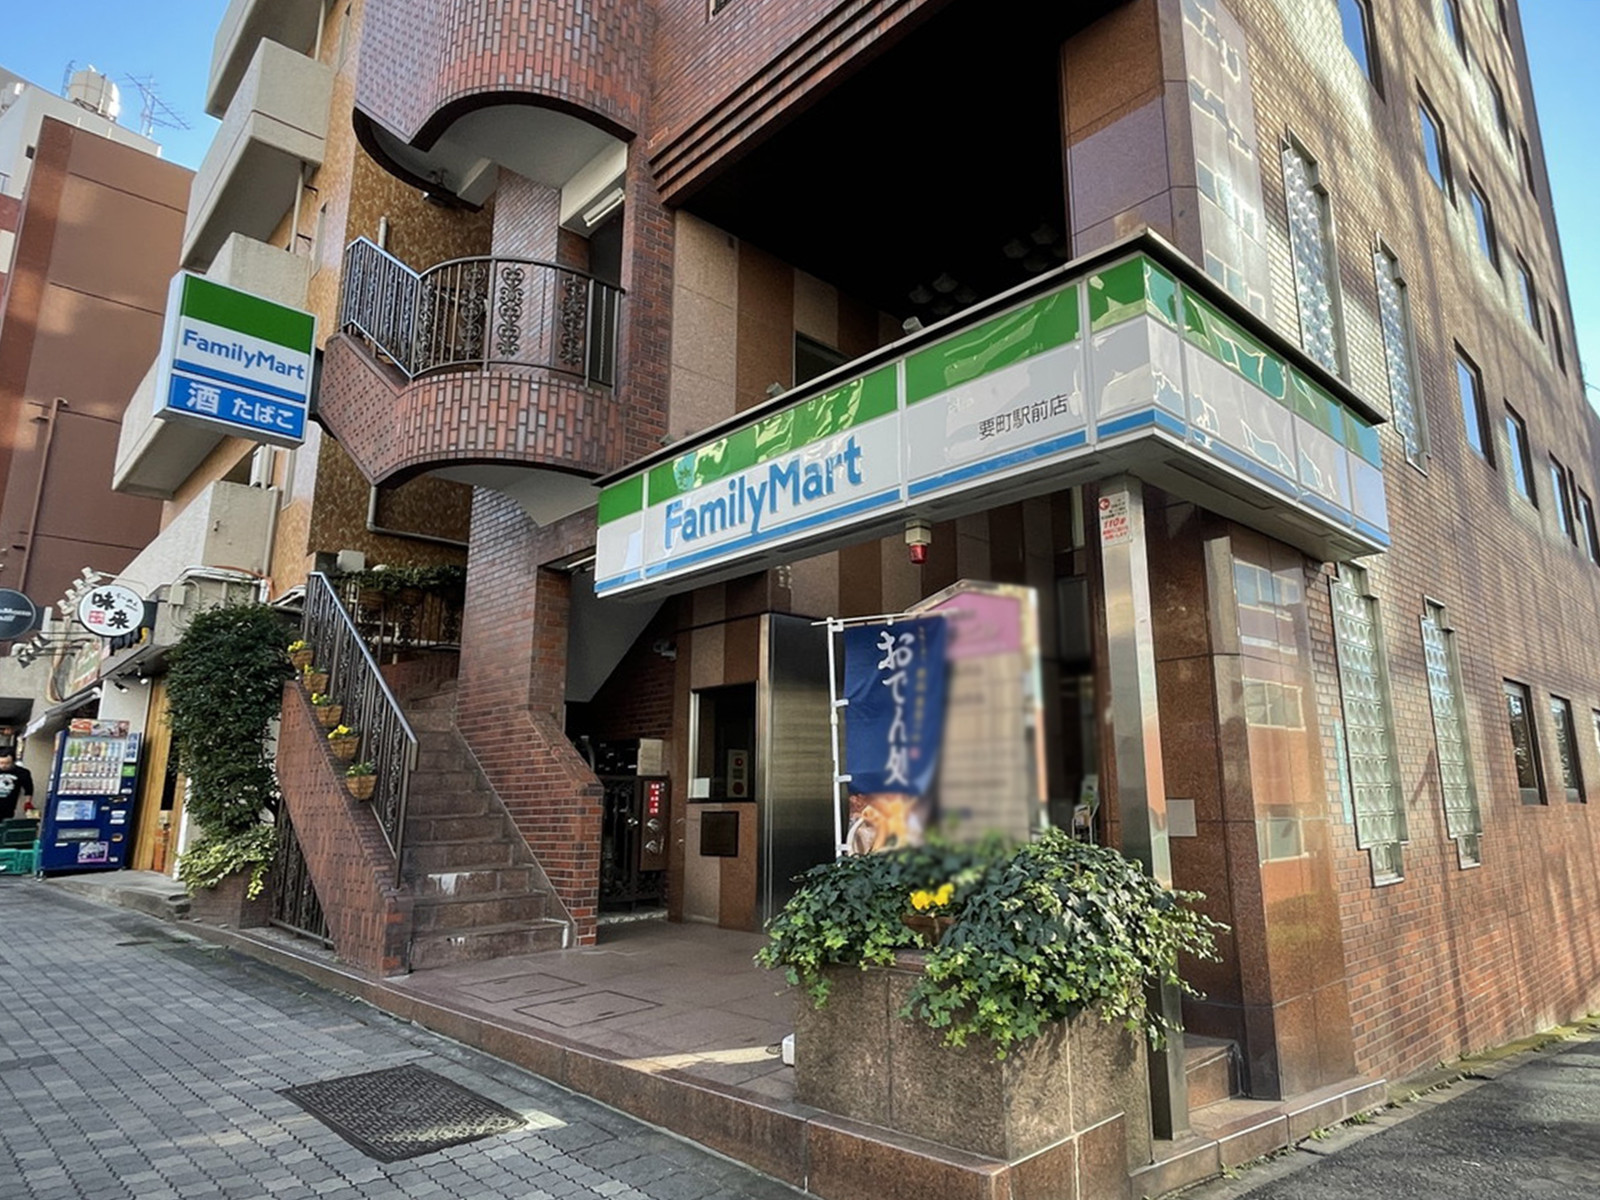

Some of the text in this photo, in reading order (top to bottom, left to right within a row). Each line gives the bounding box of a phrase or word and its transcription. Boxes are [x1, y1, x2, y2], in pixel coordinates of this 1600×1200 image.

[183, 329, 305, 380] FamilyMart
[186, 382, 294, 430] 酒 たばこ
[978, 394, 1068, 441] 要町駅前店
[664, 435, 863, 550] FamilyMart
[877, 630, 915, 786] おでん処
